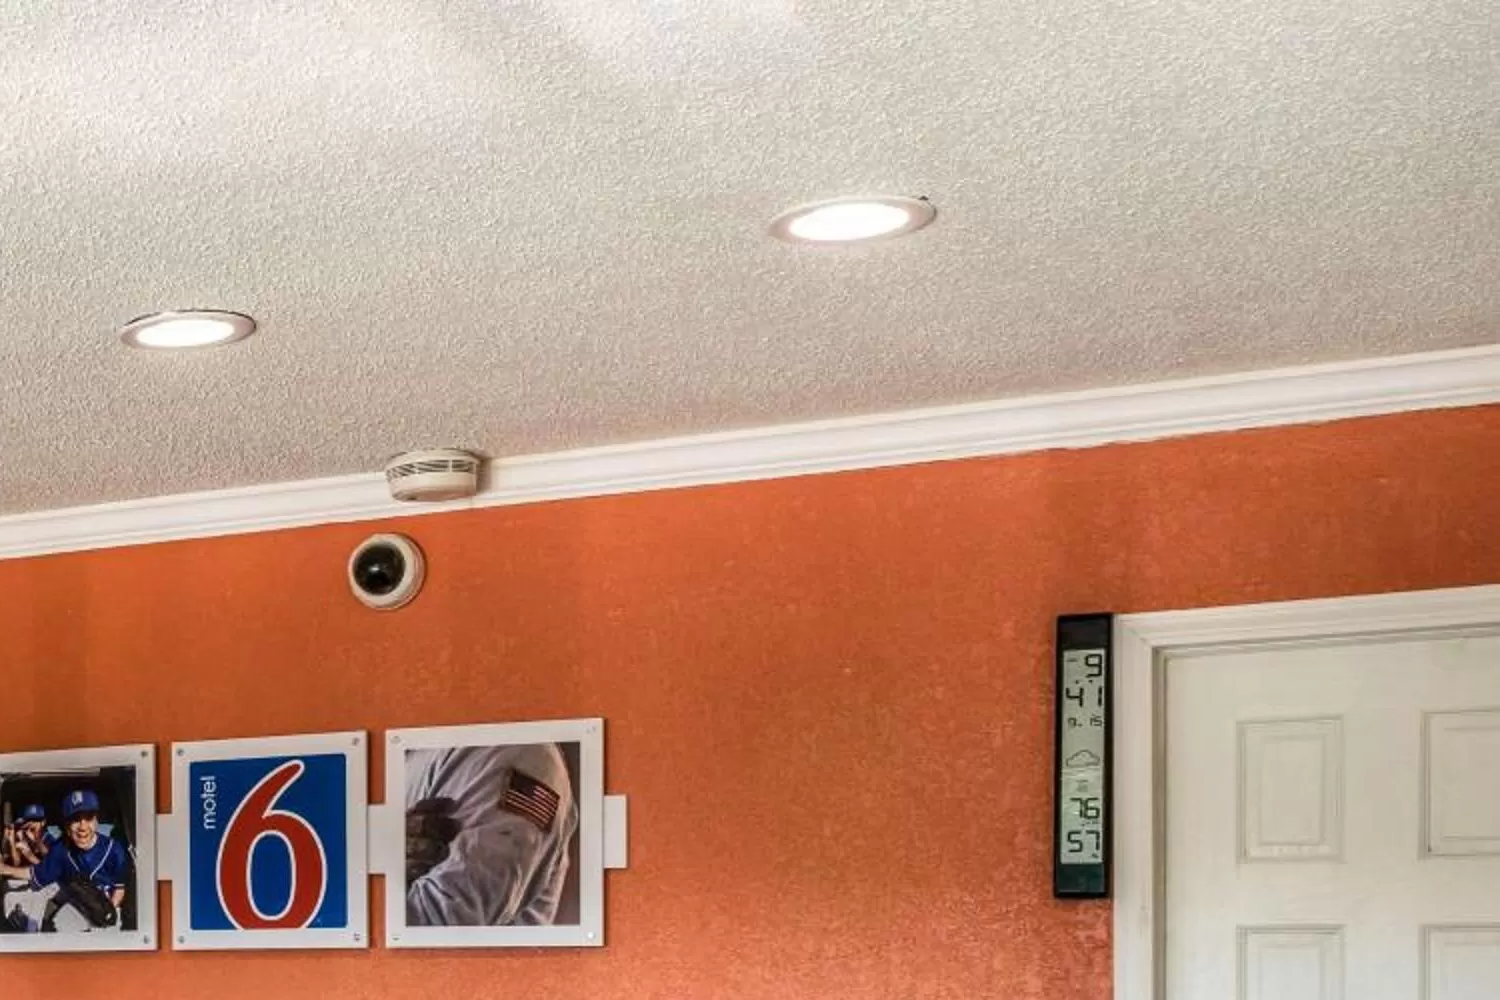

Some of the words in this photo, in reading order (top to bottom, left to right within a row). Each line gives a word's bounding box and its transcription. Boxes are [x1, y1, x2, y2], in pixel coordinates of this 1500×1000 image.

[1065, 686, 1103, 708] 41
[1069, 797, 1101, 820] 76
[200, 775, 217, 830] motel
[216, 759, 328, 930] 6
[1067, 829, 1101, 853] 57
